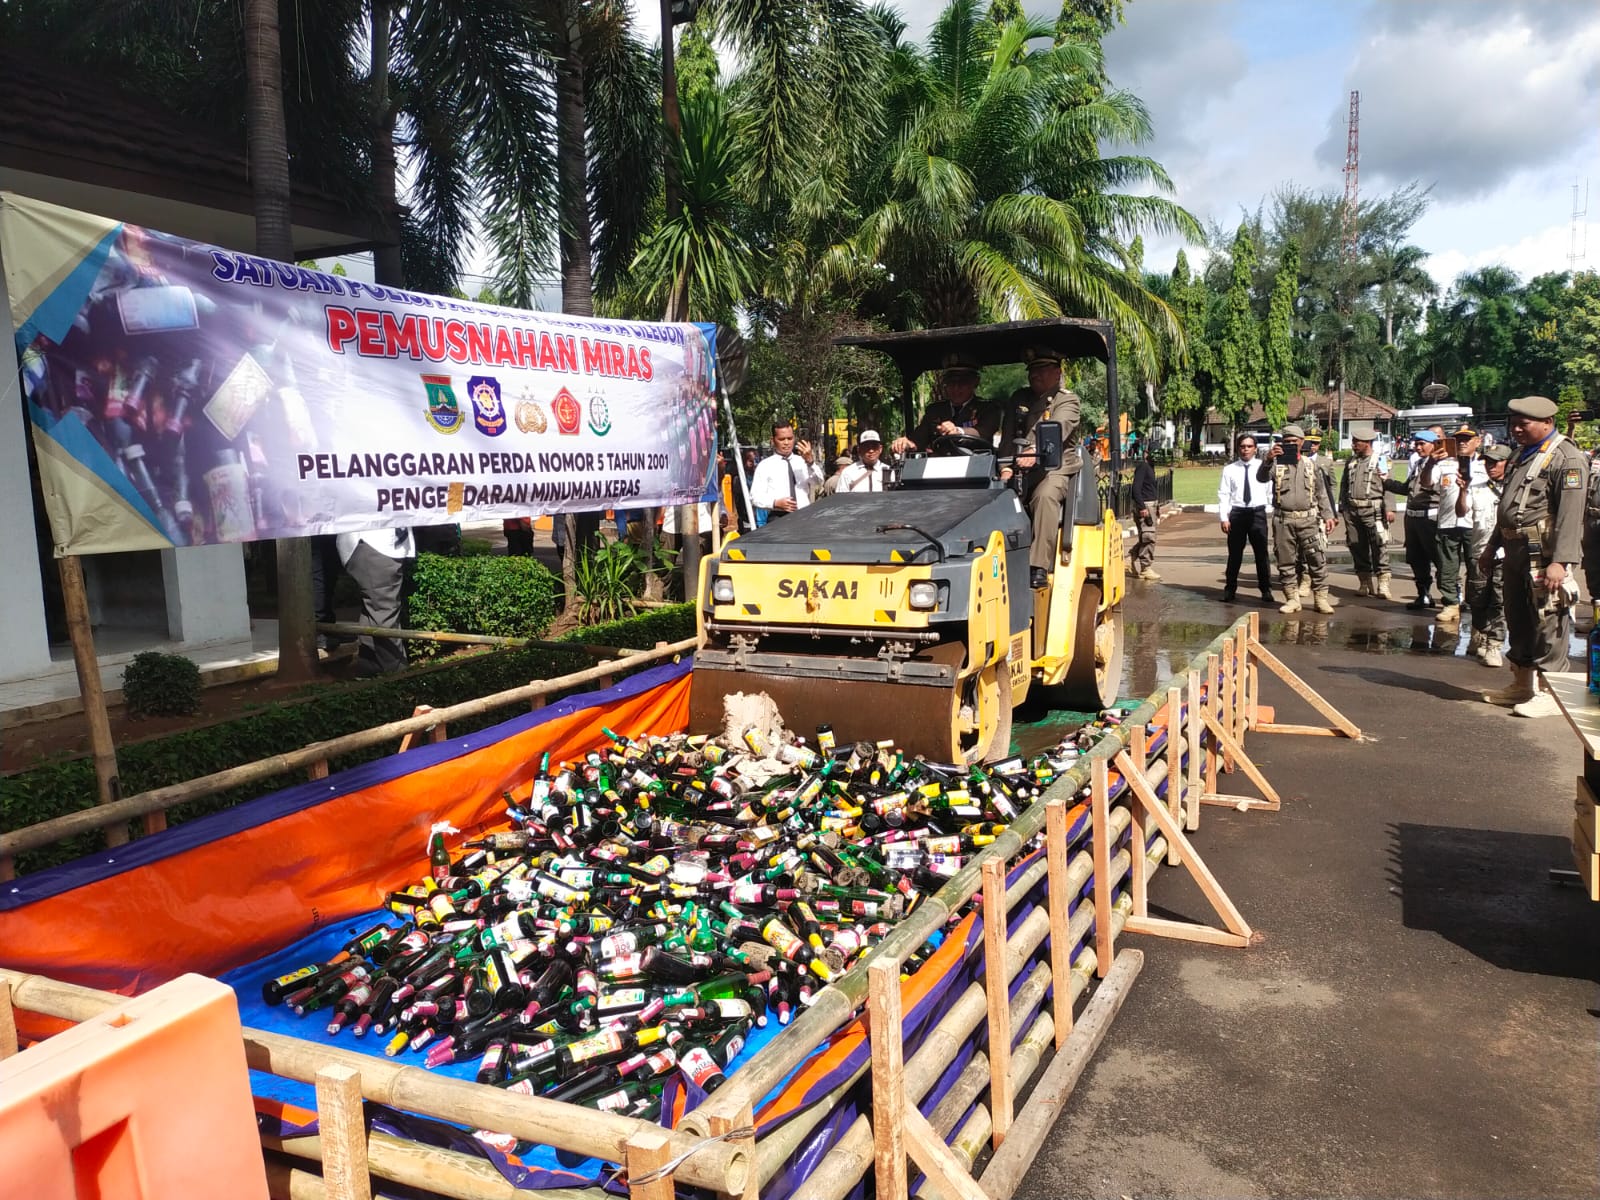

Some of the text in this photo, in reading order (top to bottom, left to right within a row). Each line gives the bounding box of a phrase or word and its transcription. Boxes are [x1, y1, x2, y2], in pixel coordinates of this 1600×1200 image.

[211, 250, 345, 296] SATUAN
[324, 305, 654, 382] PEMUSNAHAN MIRAS
[298, 453, 669, 479] PELANGGARAN PERDA NOMOR 5 TAHUN 2001
[377, 479, 641, 511] PENGEDARAN MINUMAN KERAS
[777, 579, 858, 599] SAKAI
